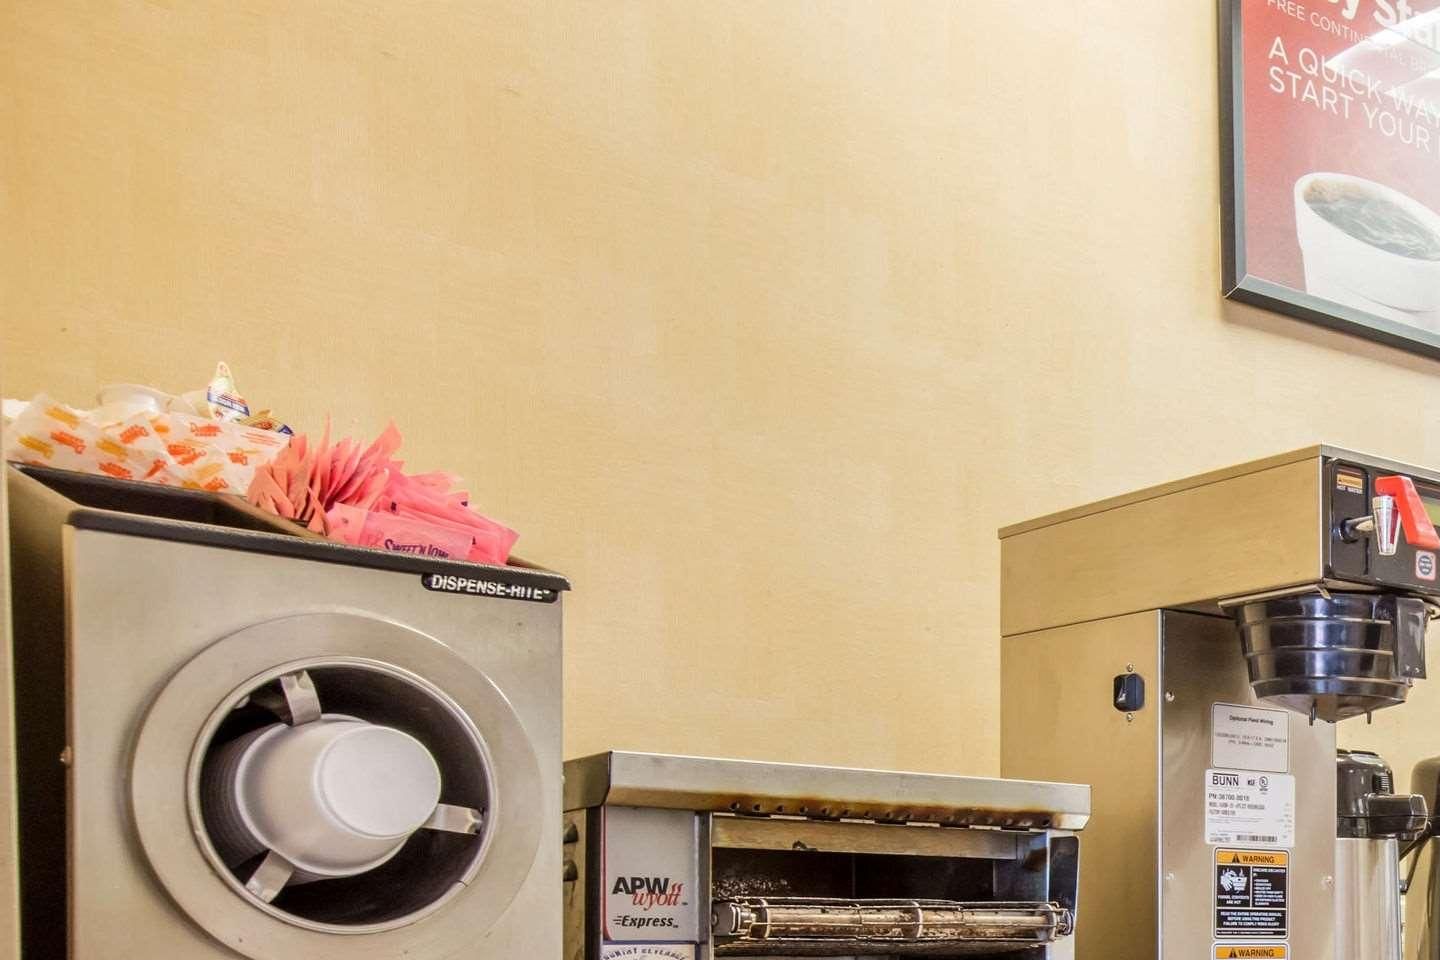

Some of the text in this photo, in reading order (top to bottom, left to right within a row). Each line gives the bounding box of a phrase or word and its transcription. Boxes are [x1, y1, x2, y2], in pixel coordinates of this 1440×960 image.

[1268, 36, 1289, 65] A
[1298, 47, 1383, 105] QUICK
[1269, 66, 1355, 119] START
[1362, 102, 1431, 153] YOUR
[1213, 776, 1239, 786] BUNN
[1242, 856, 1274, 864] WARNING
[612, 877, 670, 894] APW
[622, 916, 674, 928] Express
[1239, 949, 1274, 957] WARNING
